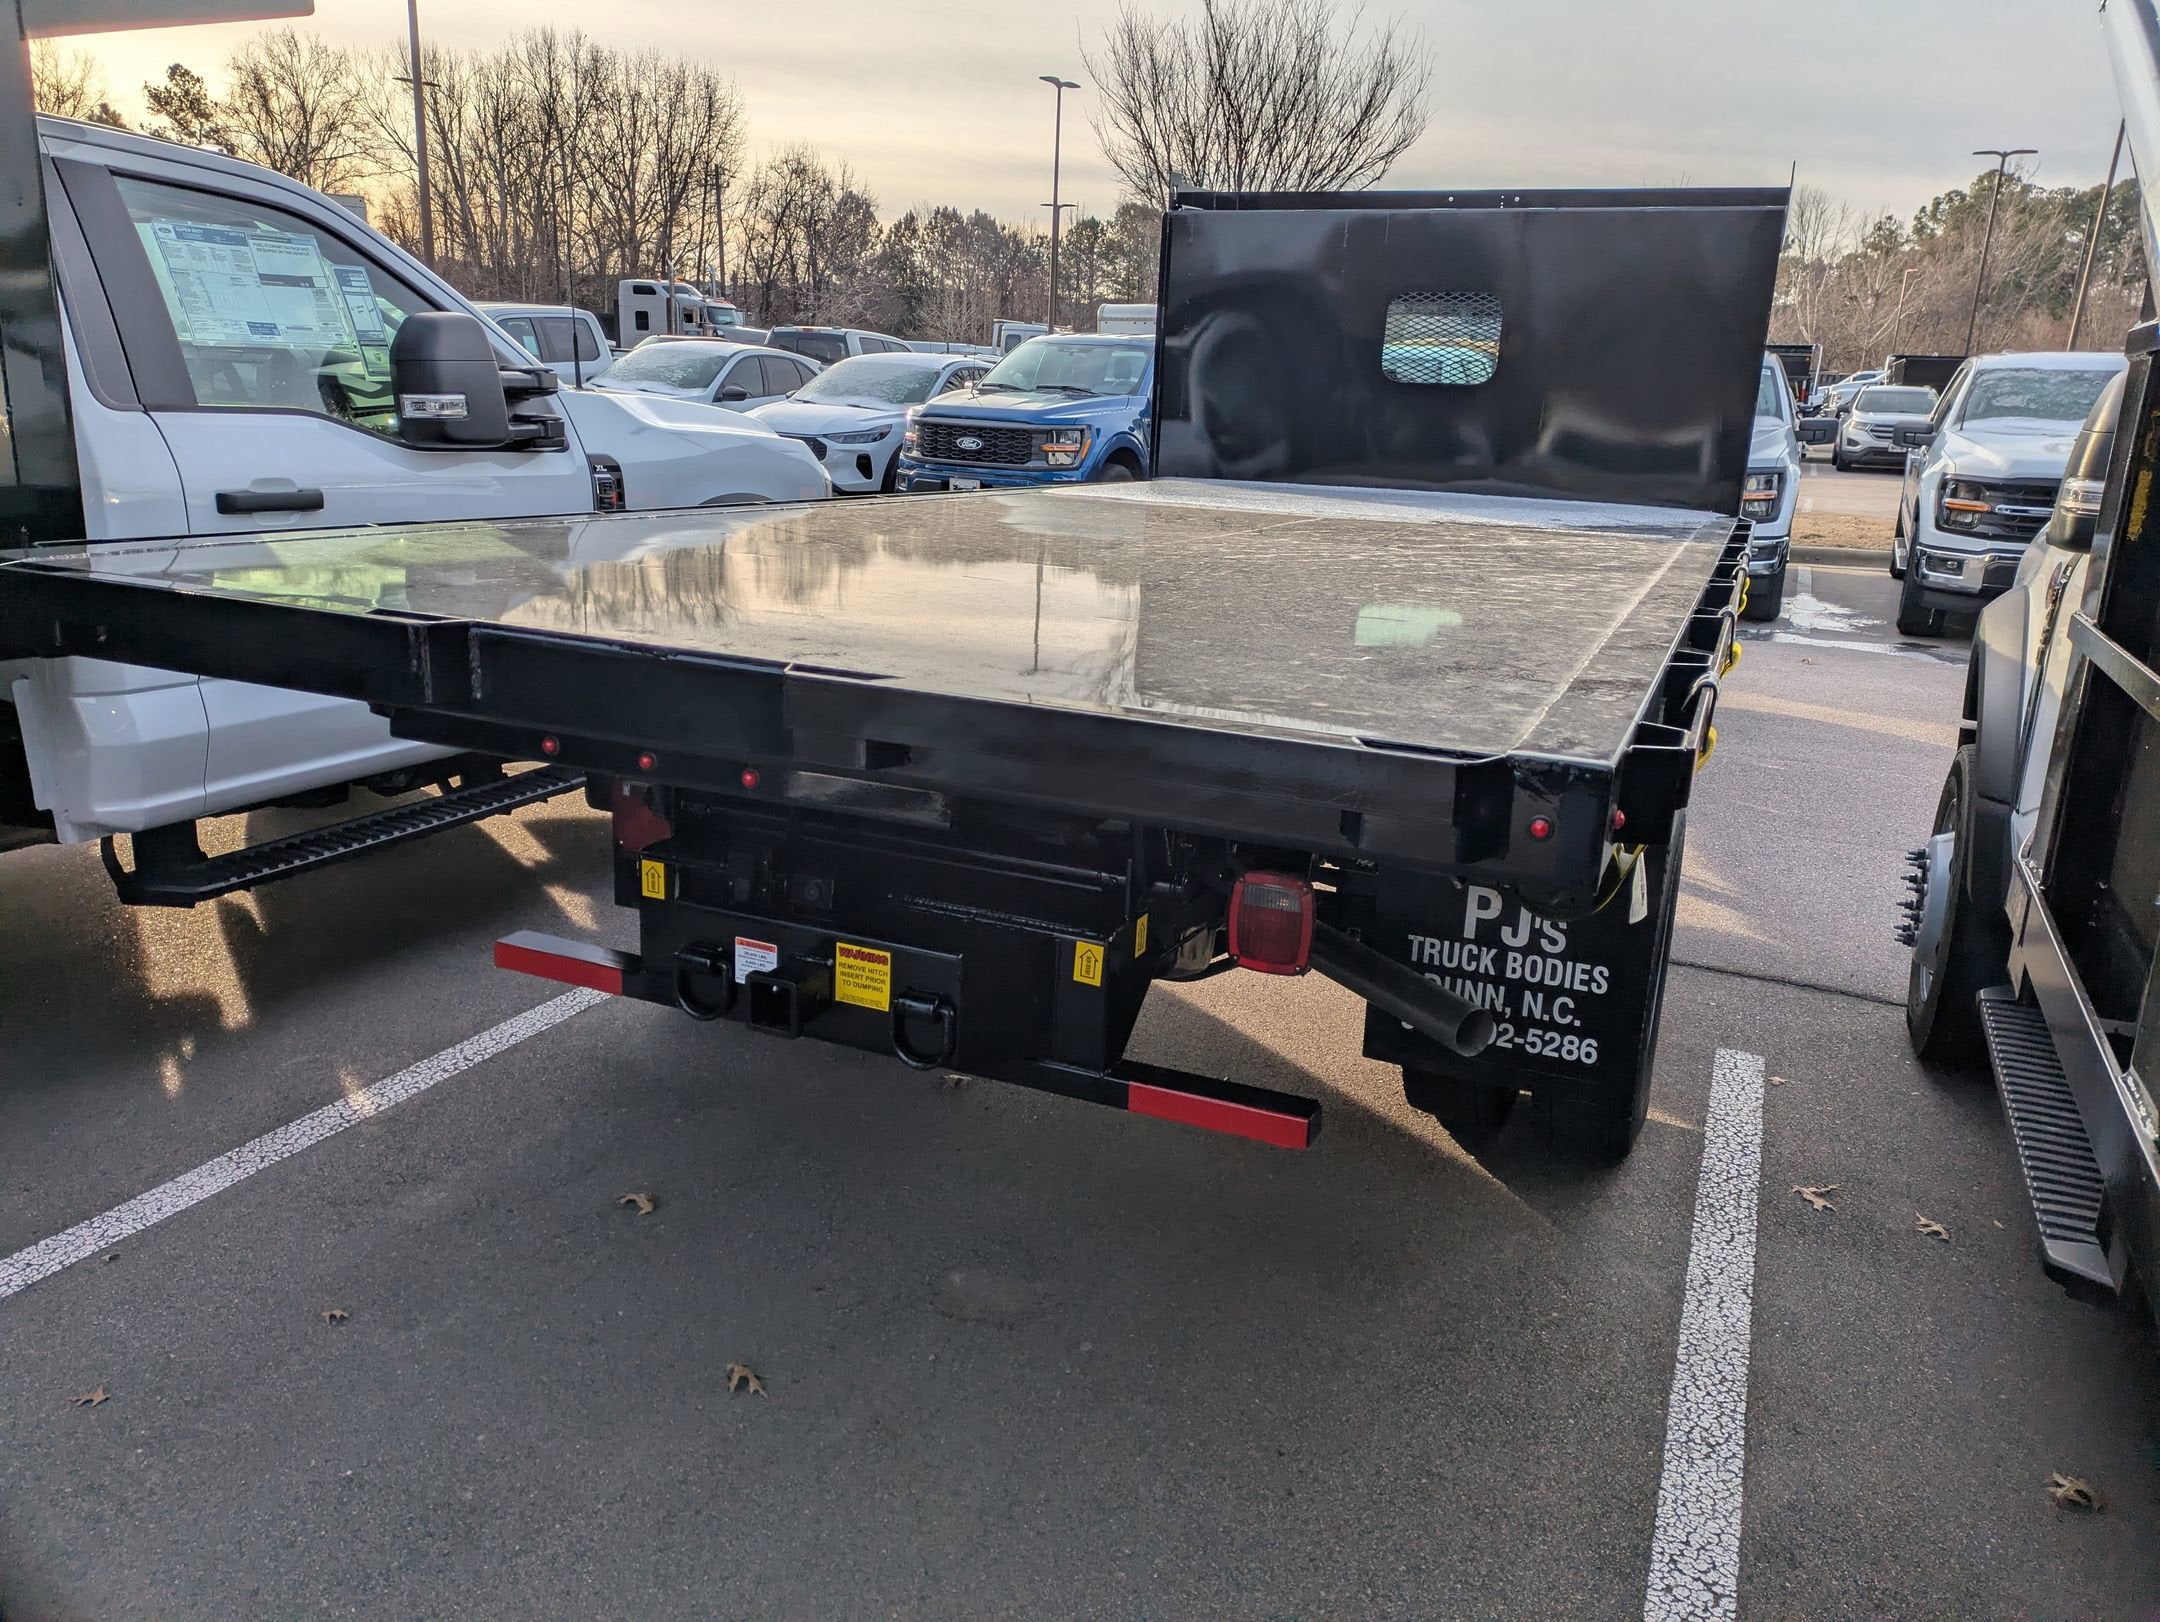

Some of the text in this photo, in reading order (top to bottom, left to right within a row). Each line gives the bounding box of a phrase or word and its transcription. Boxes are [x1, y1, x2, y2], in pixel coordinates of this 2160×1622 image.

[594, 464, 608, 472] XL
[838, 946, 889, 966] WARNING
[838, 961, 888, 977] REMOVE HITCH
[1408, 934, 1610, 995] TRUCK BODIES
[840, 970, 886, 985] INSERT PRIOR
[852, 982, 884, 993] DUMPING
[1522, 990, 1581, 1027] N.C.
